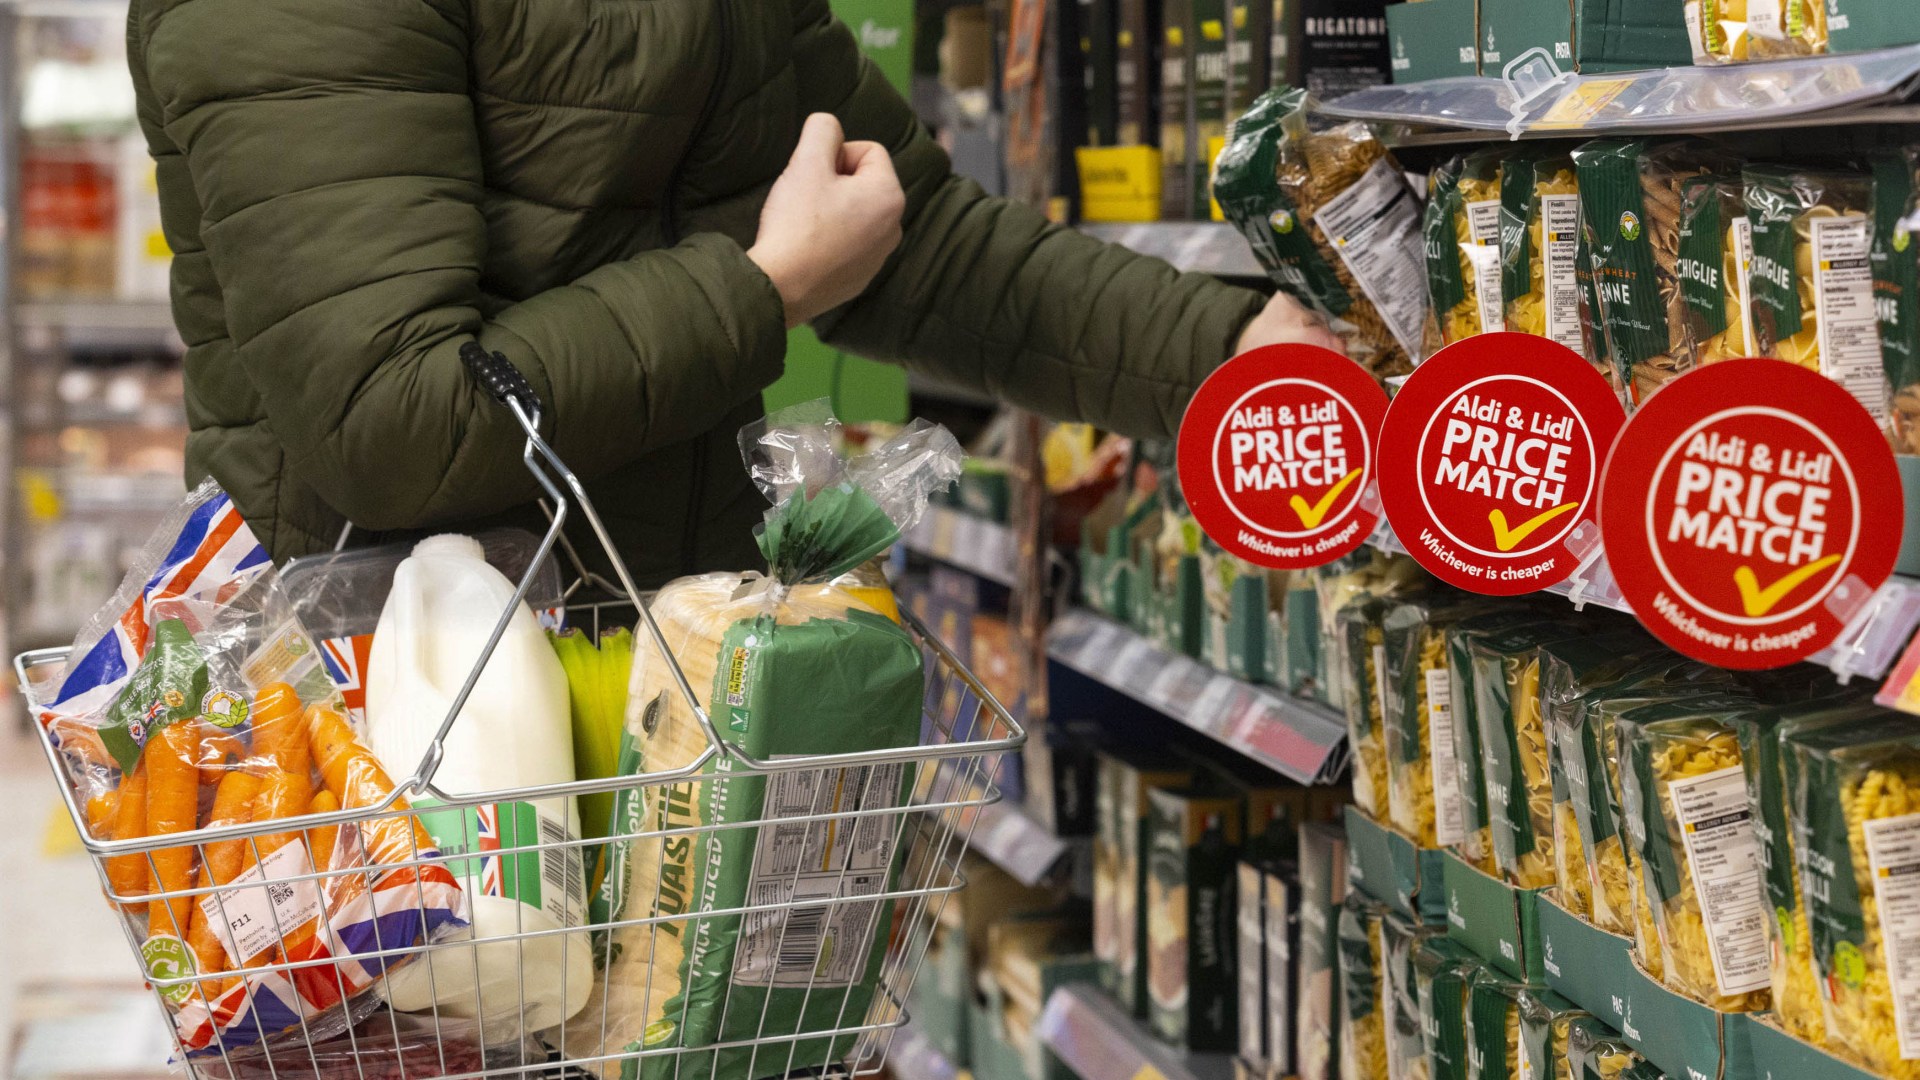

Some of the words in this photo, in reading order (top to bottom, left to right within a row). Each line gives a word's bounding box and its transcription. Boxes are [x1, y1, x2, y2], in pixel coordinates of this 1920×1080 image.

[1598, 282, 1630, 305] ENNE
[1231, 406, 1273, 430] Aldi
[1277, 405, 1296, 426] &
[1300, 399, 1339, 424] Lidl
[1452, 394, 1502, 424] Aldi
[1505, 406, 1524, 430] &
[1530, 412, 1574, 441] Lidl
[1231, 424, 1346, 466] PRICE
[1441, 418, 1572, 483] PRICE
[1685, 432, 1747, 467] Aldi
[1749, 443, 1773, 473] &
[1779, 449, 1833, 485] Lidl
[1234, 457, 1348, 493] MATCH
[1434, 456, 1565, 509] MATCH
[1674, 461, 1831, 534] PRICE
[1237, 529, 1301, 558] Whichever
[1302, 543, 1314, 556] is
[1315, 520, 1360, 553] cheaper
[1419, 528, 1484, 577] Whichever
[1485, 565, 1498, 580] is
[1500, 558, 1556, 581] cheaper
[1667, 506, 1824, 566] MATCH
[1652, 591, 1733, 649] Whichever
[1733, 633, 1749, 652] is
[1751, 622, 1817, 652] cheaper
[742, 711, 750, 731] VEGAN
[708, 757, 732, 824] WHITE
[1696, 819, 1721, 830] ALLERGY
[1721, 814, 1742, 825] ADVICE
[702, 836, 723, 913] SLICED
[231, 913, 252, 932] F11
